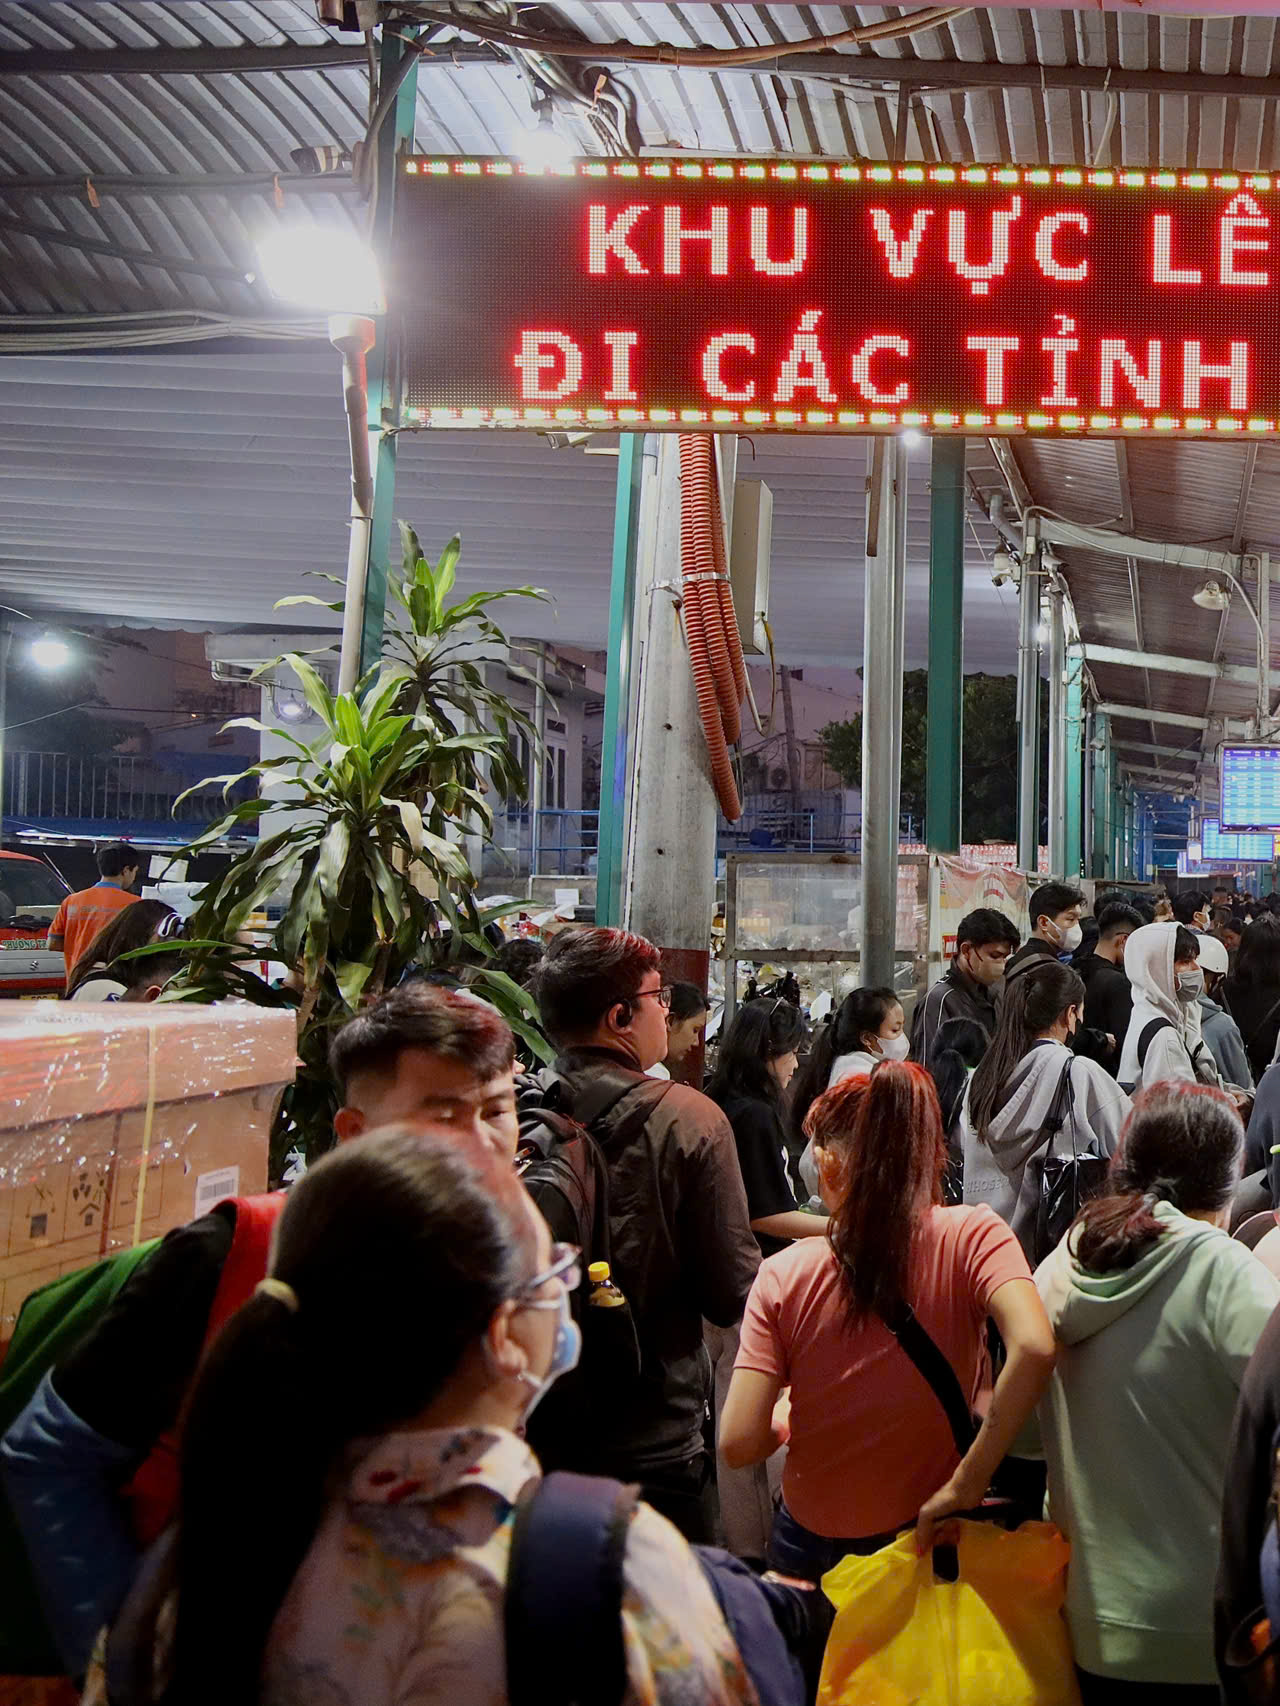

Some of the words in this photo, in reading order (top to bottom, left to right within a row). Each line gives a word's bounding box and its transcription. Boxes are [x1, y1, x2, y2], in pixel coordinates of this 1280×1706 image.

[587, 204, 808, 276] KHU
[869, 195, 1090, 295] VỰC
[514, 330, 639, 401] ĐI
[702, 310, 912, 404] CÁC
[966, 314, 1248, 410] TỈNH
